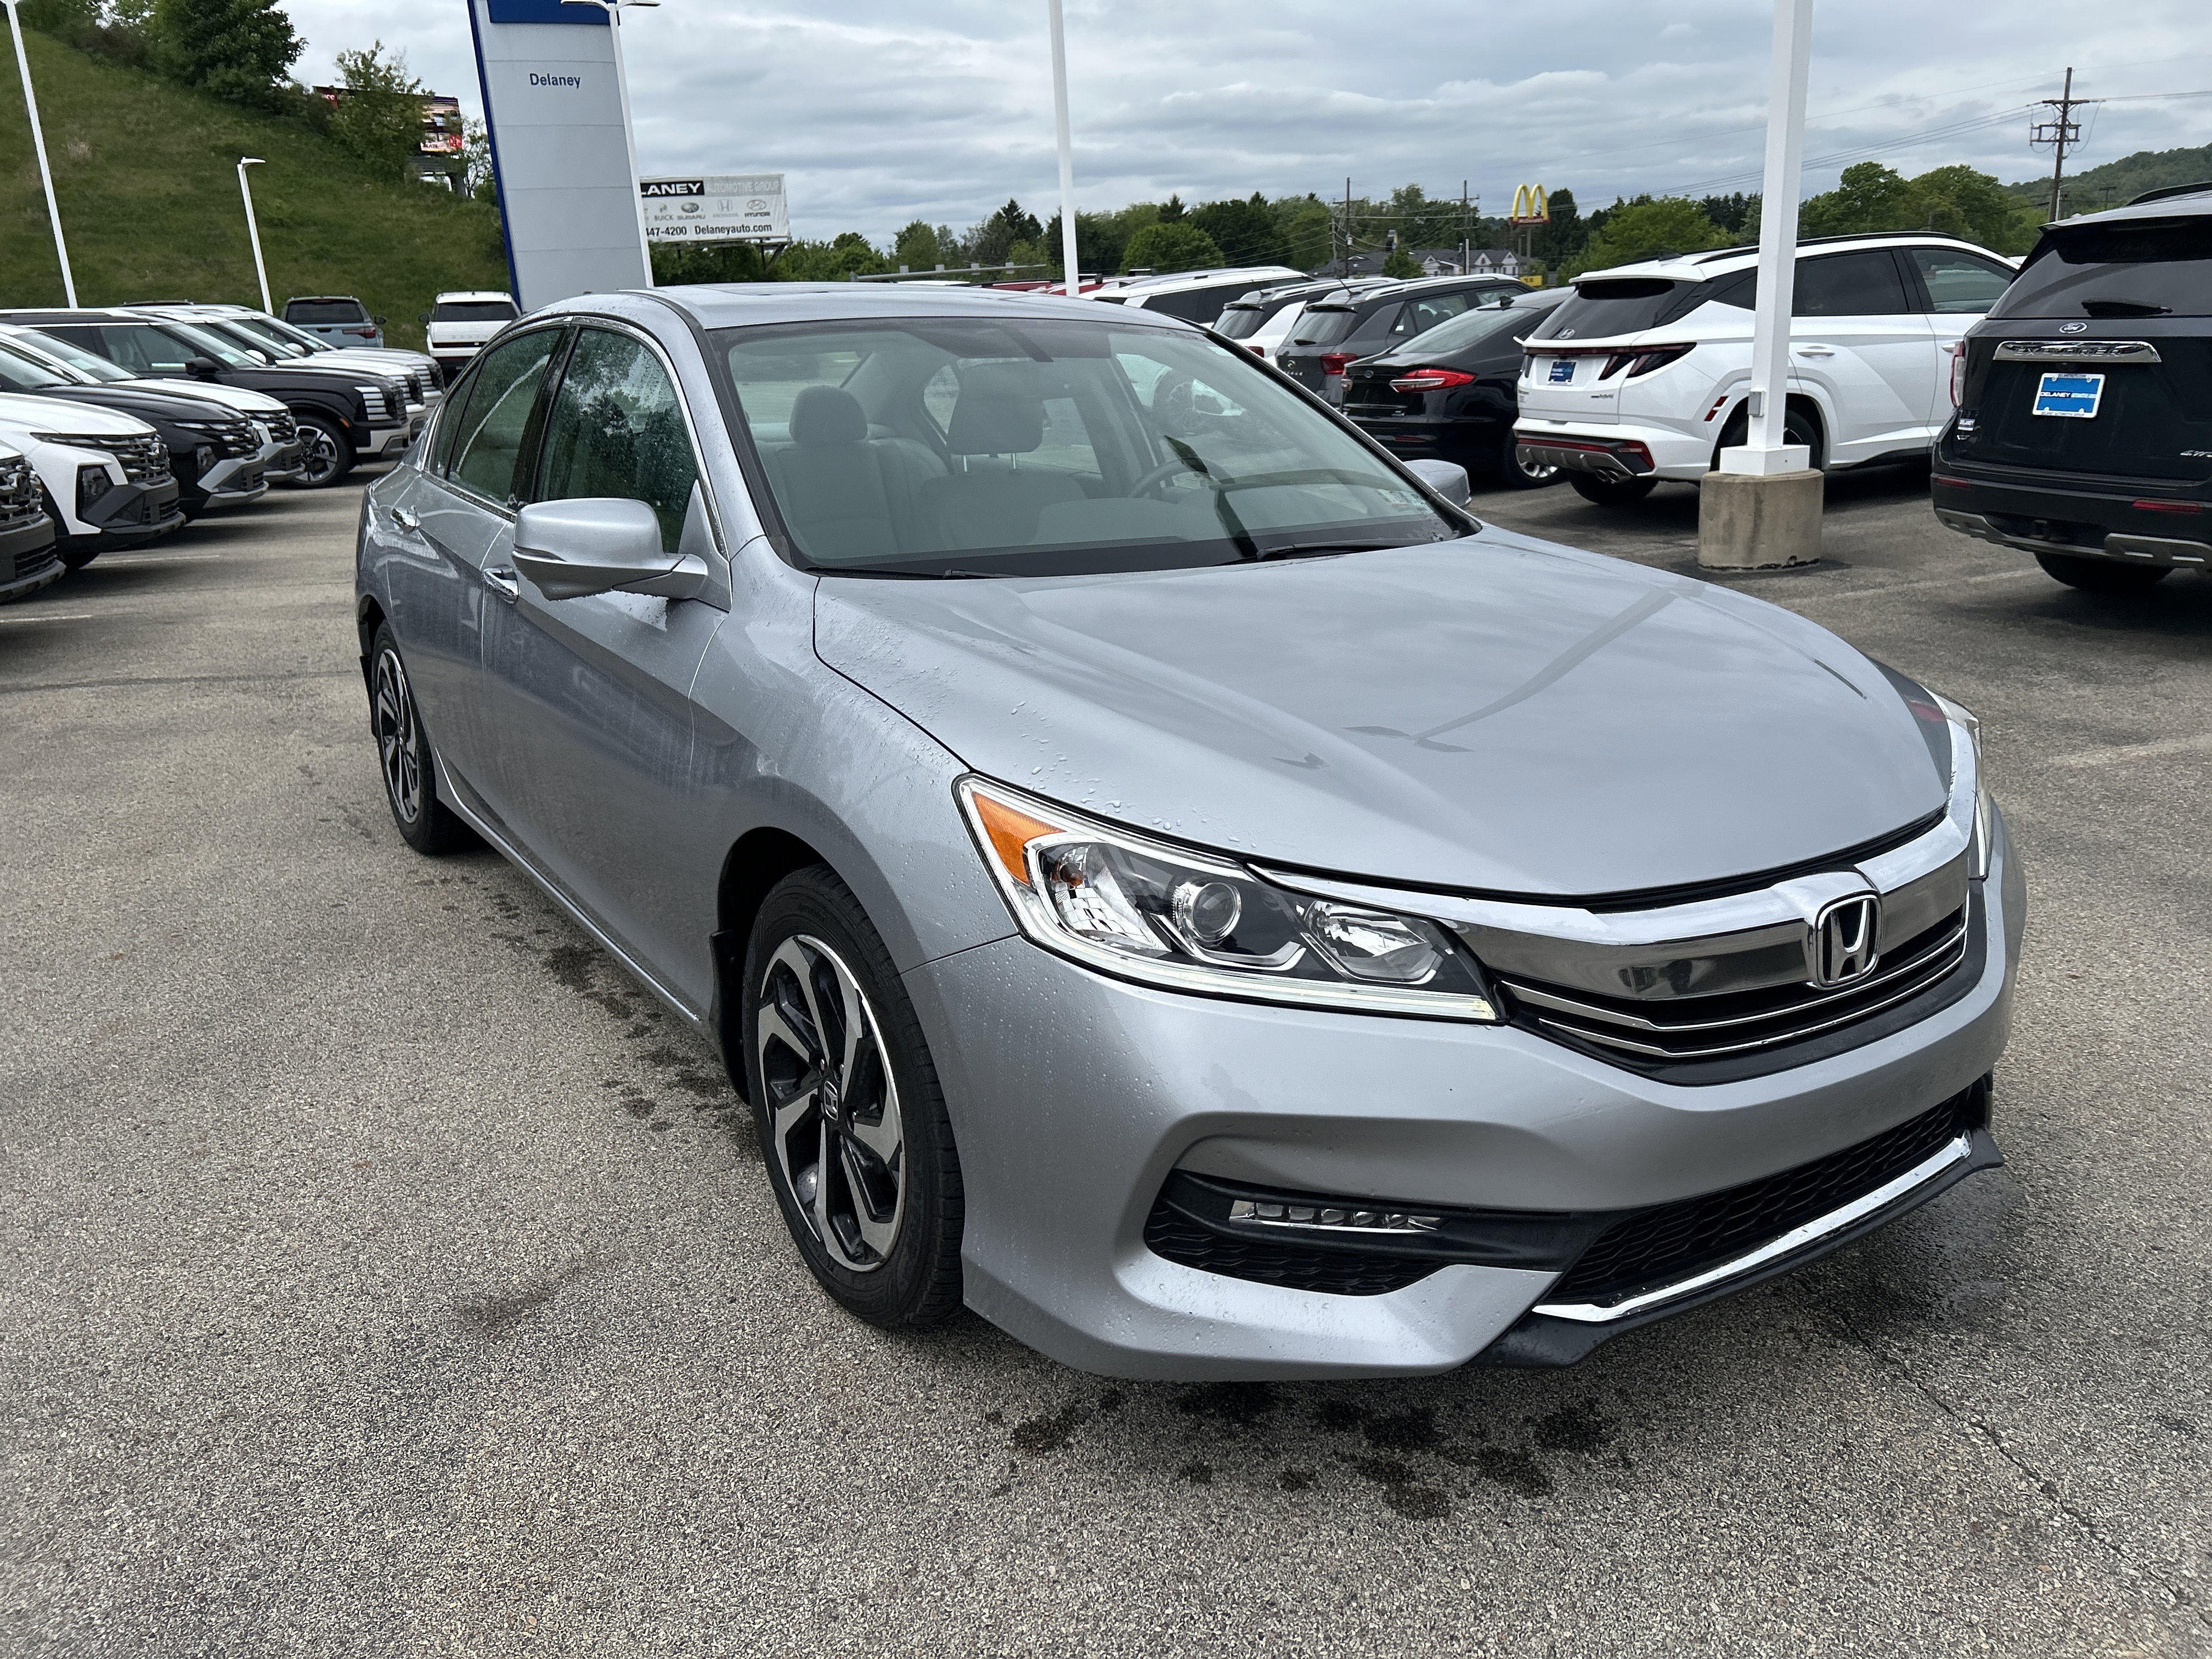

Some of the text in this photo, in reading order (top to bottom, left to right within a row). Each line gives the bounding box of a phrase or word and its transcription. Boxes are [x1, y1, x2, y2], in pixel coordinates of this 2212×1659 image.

[529, 73, 580, 89] Delaney
[695, 223, 772, 235] Delaneyauto.com
[2013, 347, 2123, 357] EXPLORER
